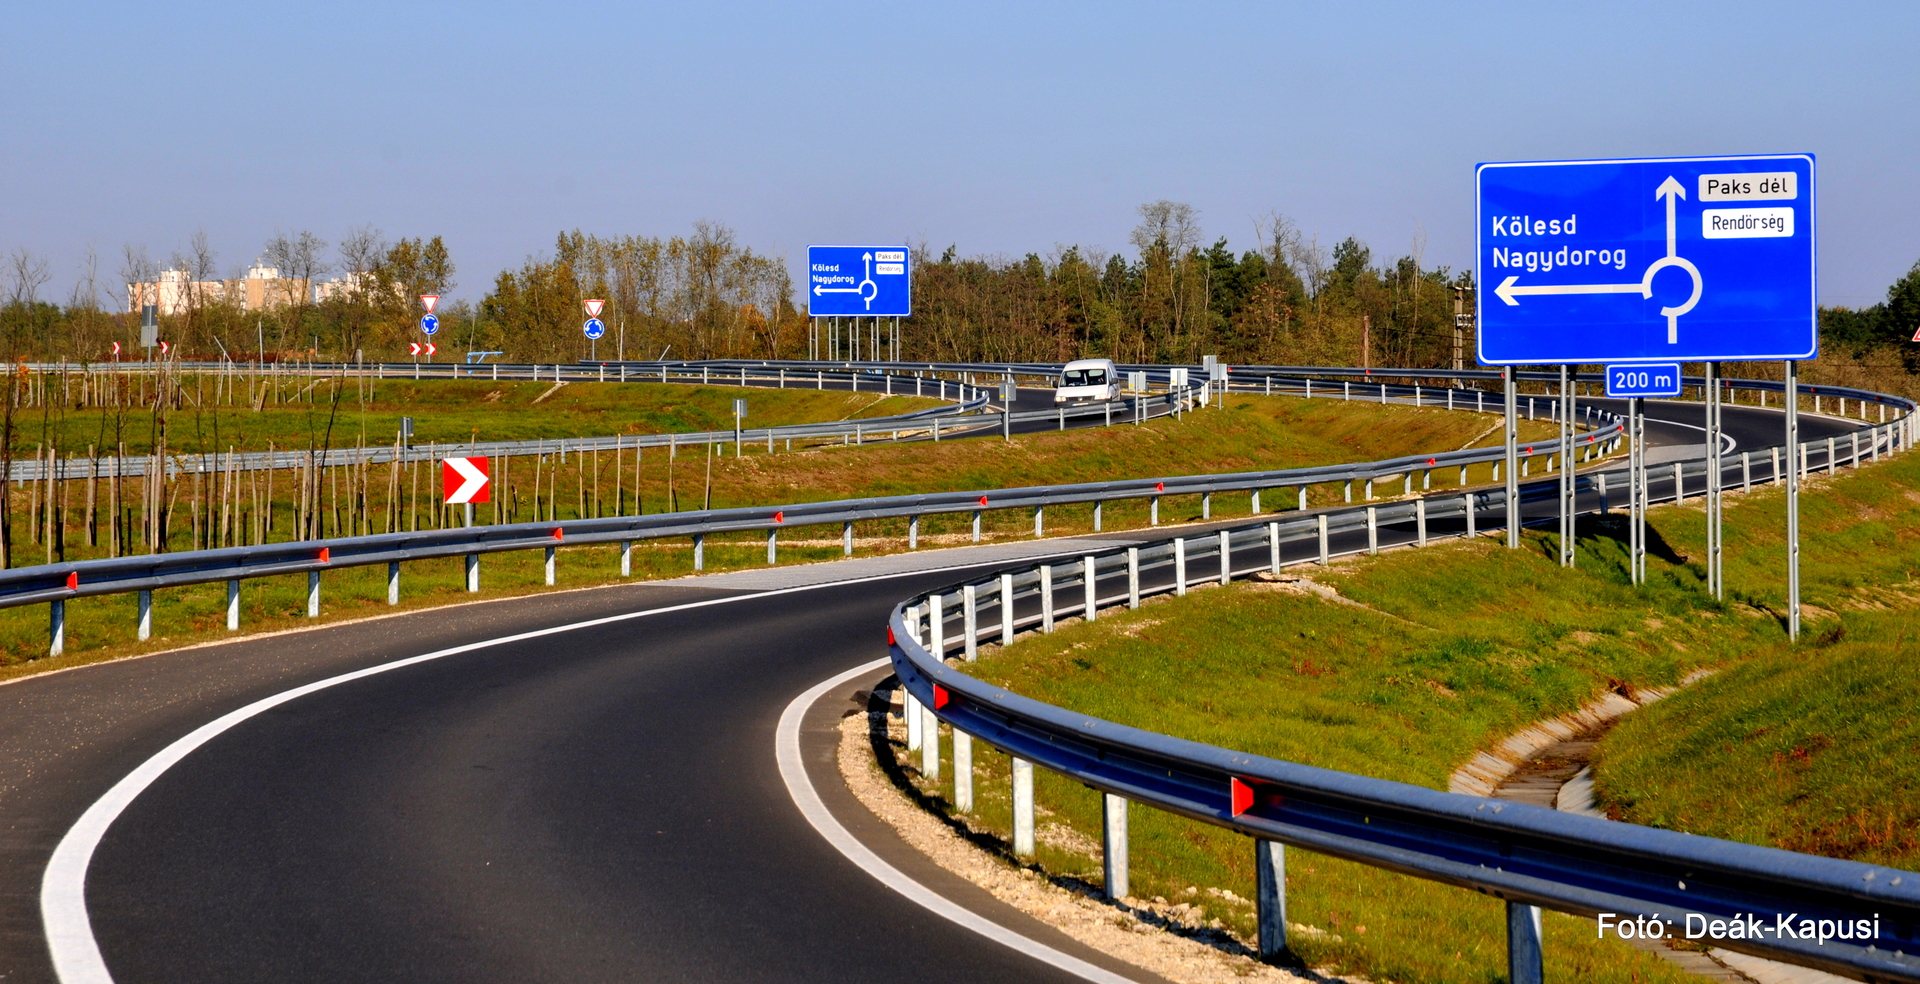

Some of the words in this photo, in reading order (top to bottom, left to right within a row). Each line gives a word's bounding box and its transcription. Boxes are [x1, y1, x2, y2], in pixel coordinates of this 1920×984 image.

[1707, 178, 1751, 195] Paks
[1492, 214, 1577, 237] Kölesd
[812, 263, 840, 272] Kölesd
[1493, 245, 1626, 273] Nagydorog
[812, 274, 855, 285] Nagydorog
[1615, 372, 1649, 389] 200
[1654, 375, 1671, 388] m
